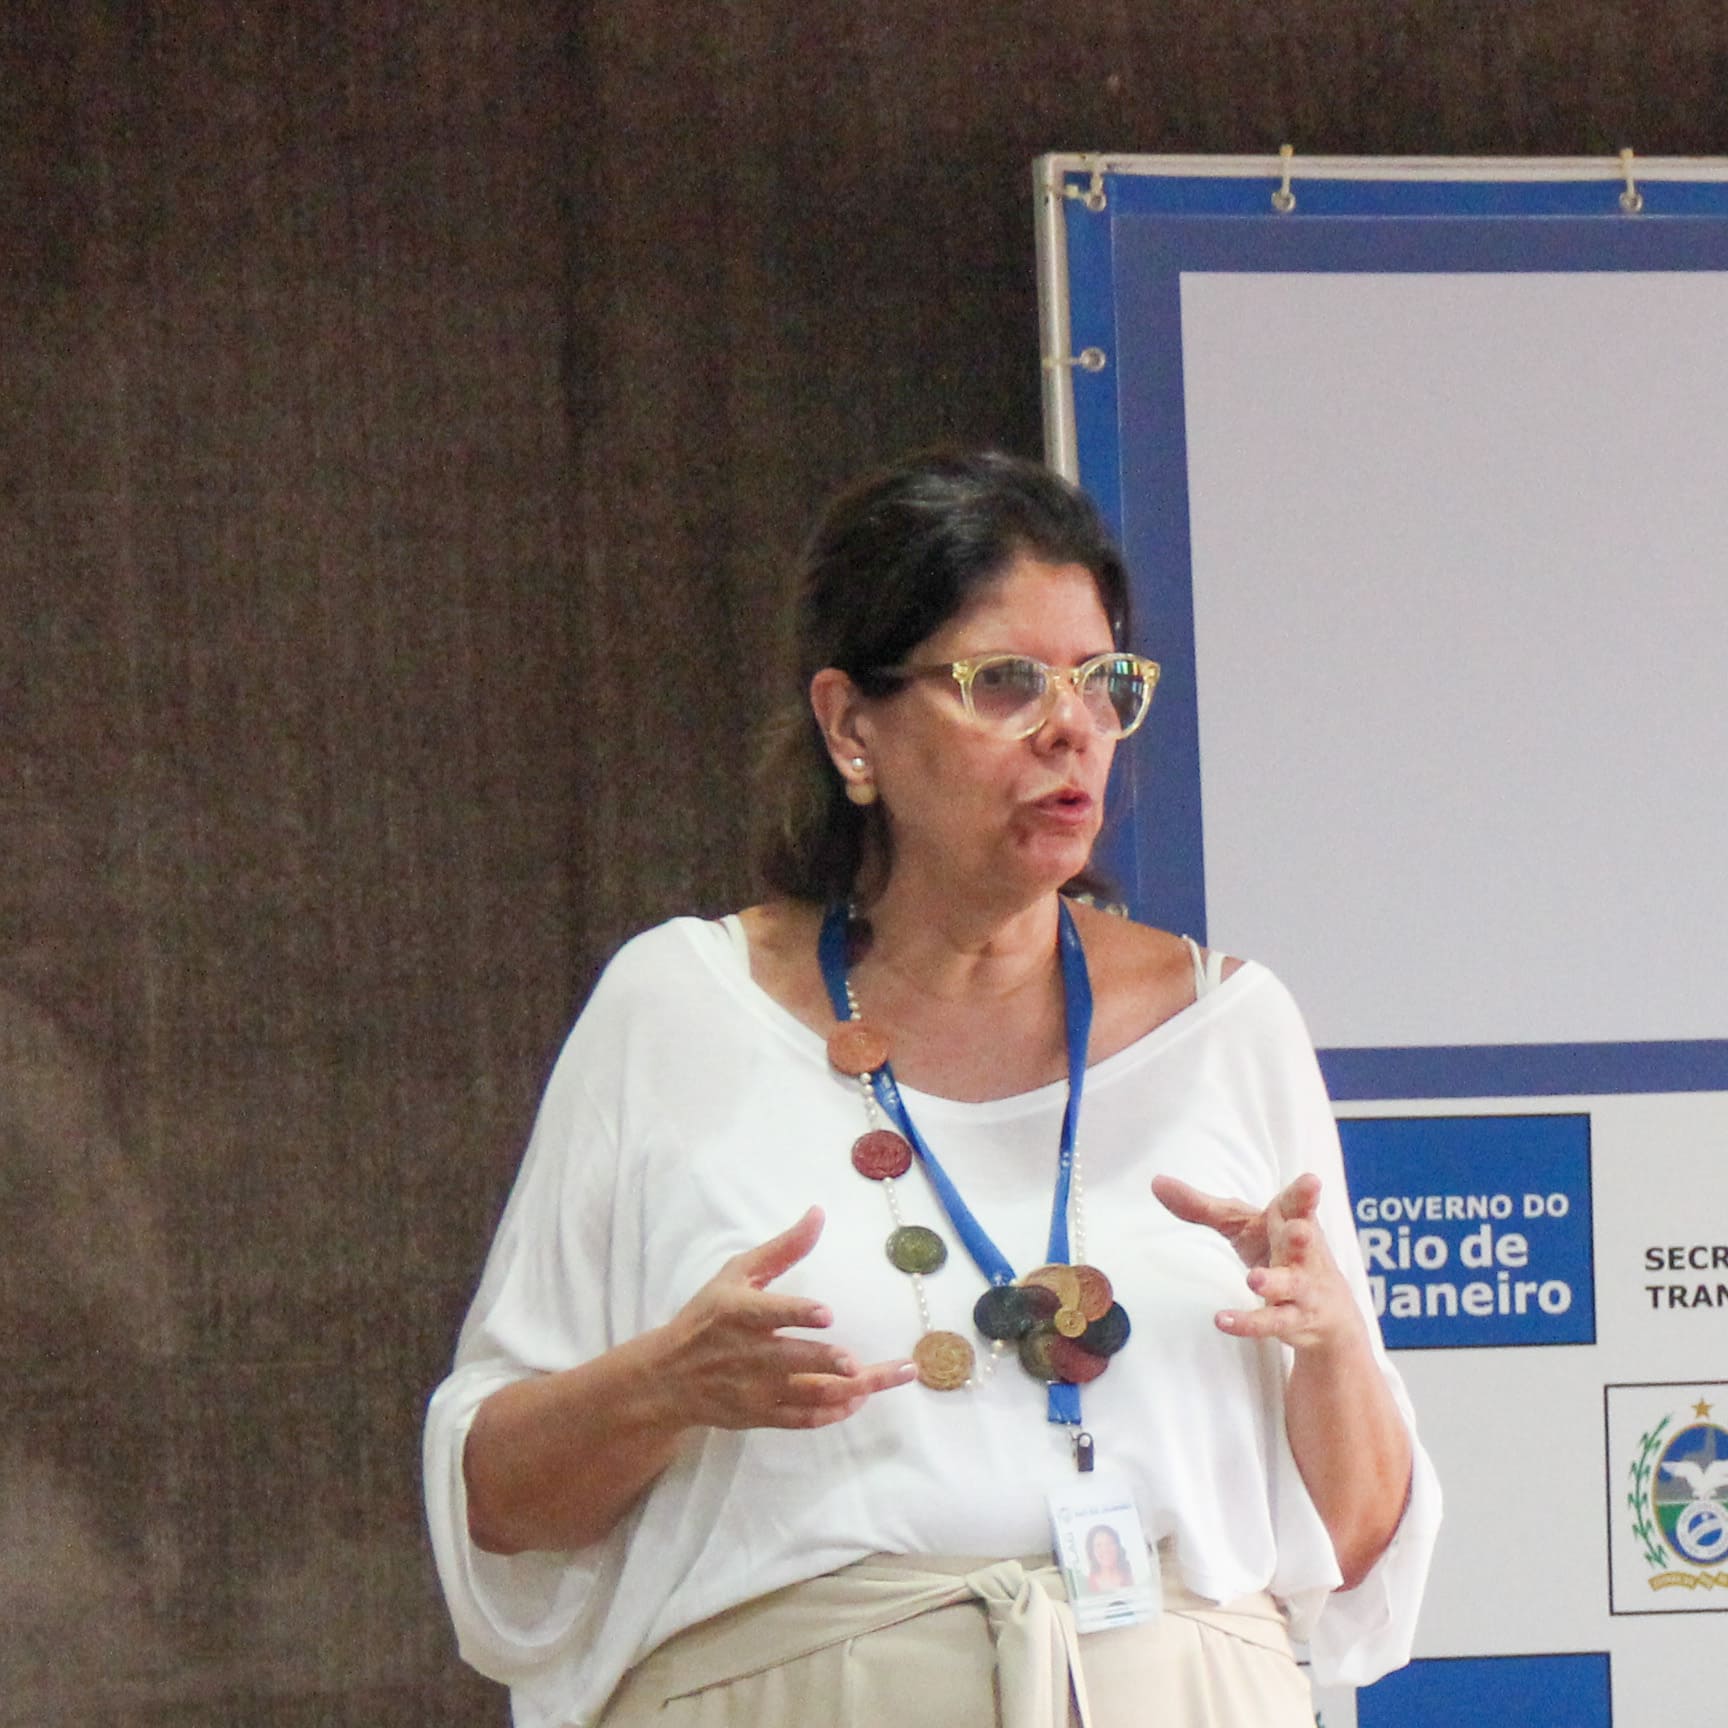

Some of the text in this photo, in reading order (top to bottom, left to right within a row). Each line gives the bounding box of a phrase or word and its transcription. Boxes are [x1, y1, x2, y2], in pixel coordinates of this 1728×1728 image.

[1357, 1193, 1569, 1221] GOVERNO DO
[1358, 1224, 1528, 1270] Rio de
